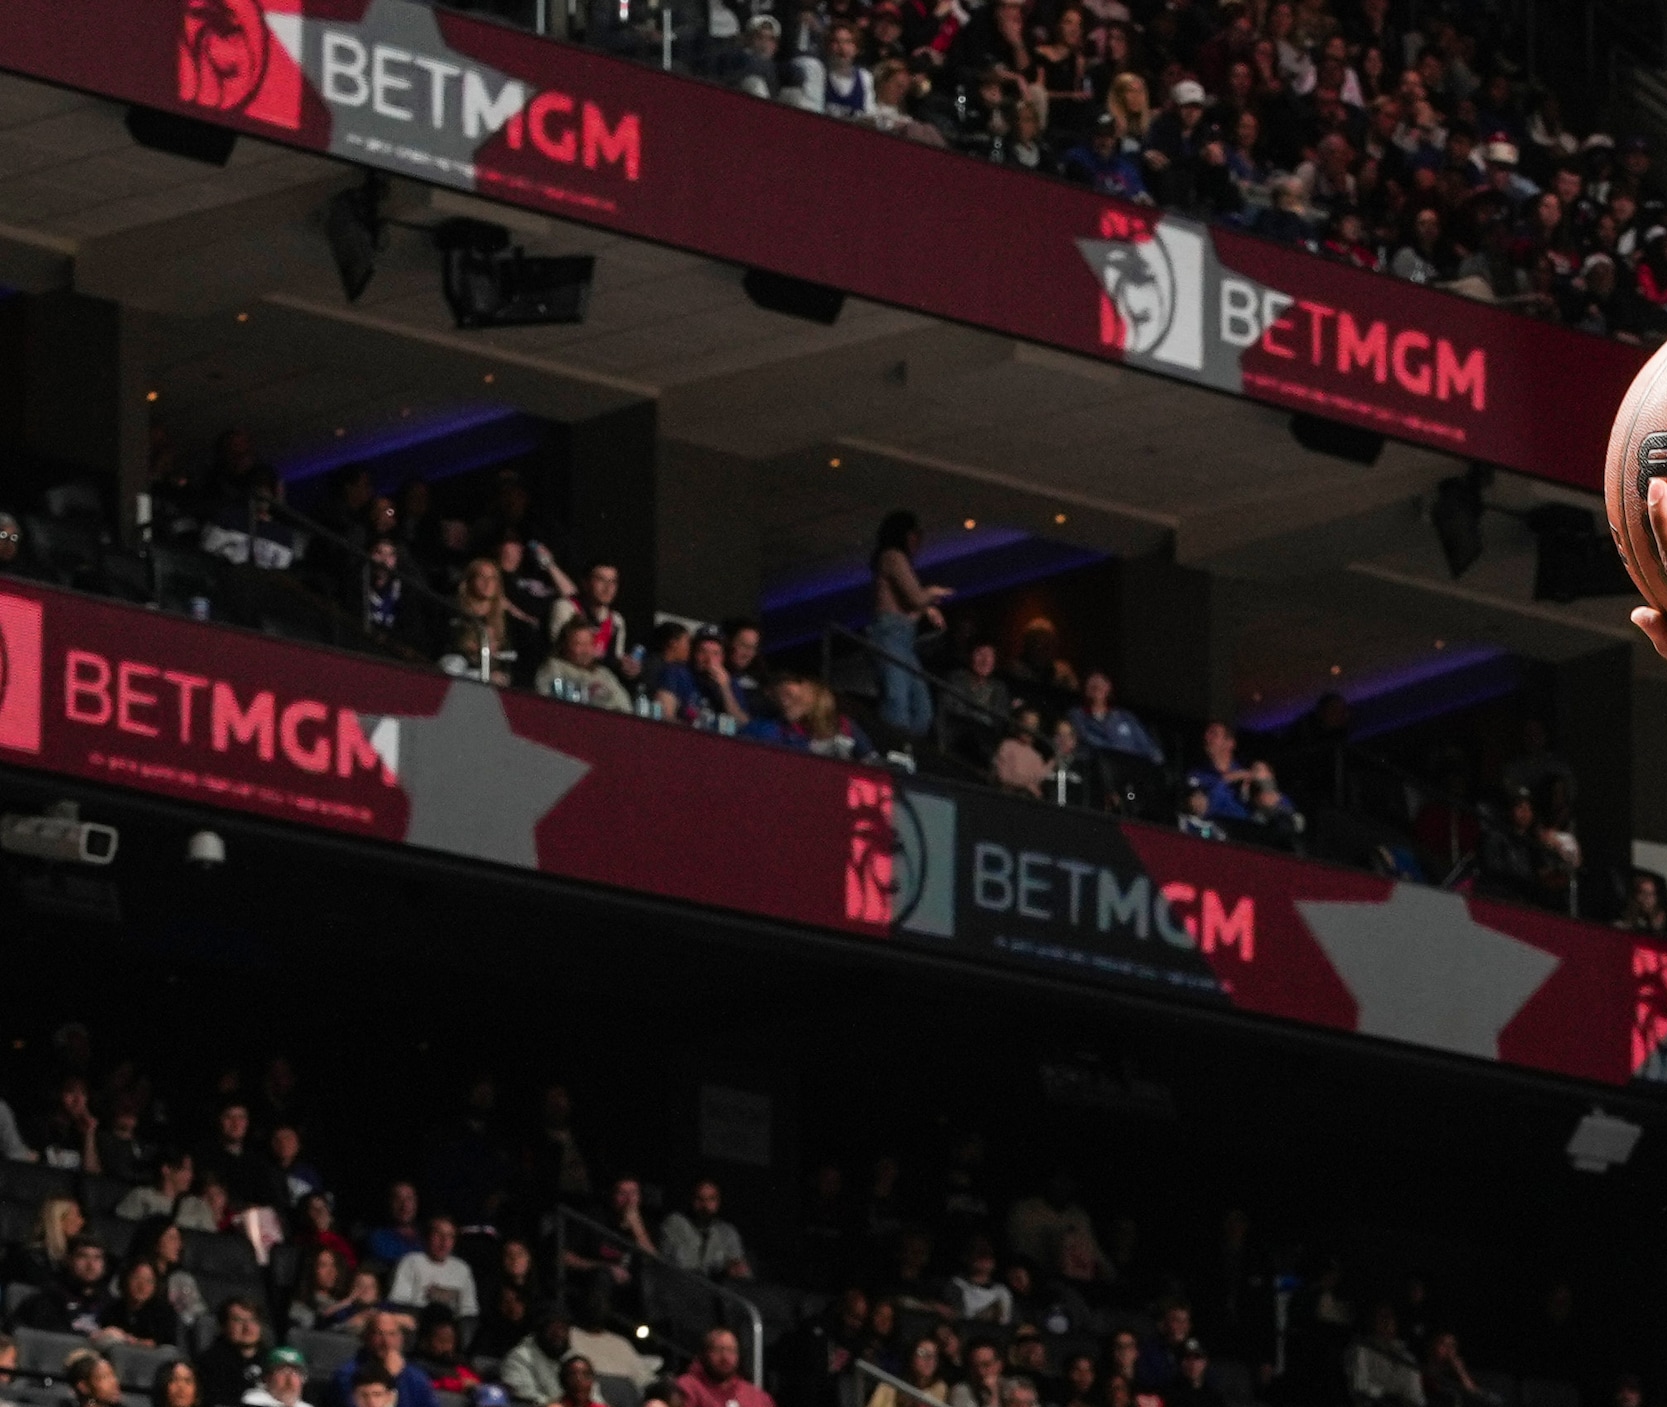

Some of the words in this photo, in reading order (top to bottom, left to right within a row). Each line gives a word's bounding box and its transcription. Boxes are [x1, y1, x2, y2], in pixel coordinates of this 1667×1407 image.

[321, 31, 642, 181] BETMGM
[1220, 279, 1486, 411] BETMGM
[64, 650, 399, 788] BETMGM
[973, 841, 1255, 963] BETMGM
